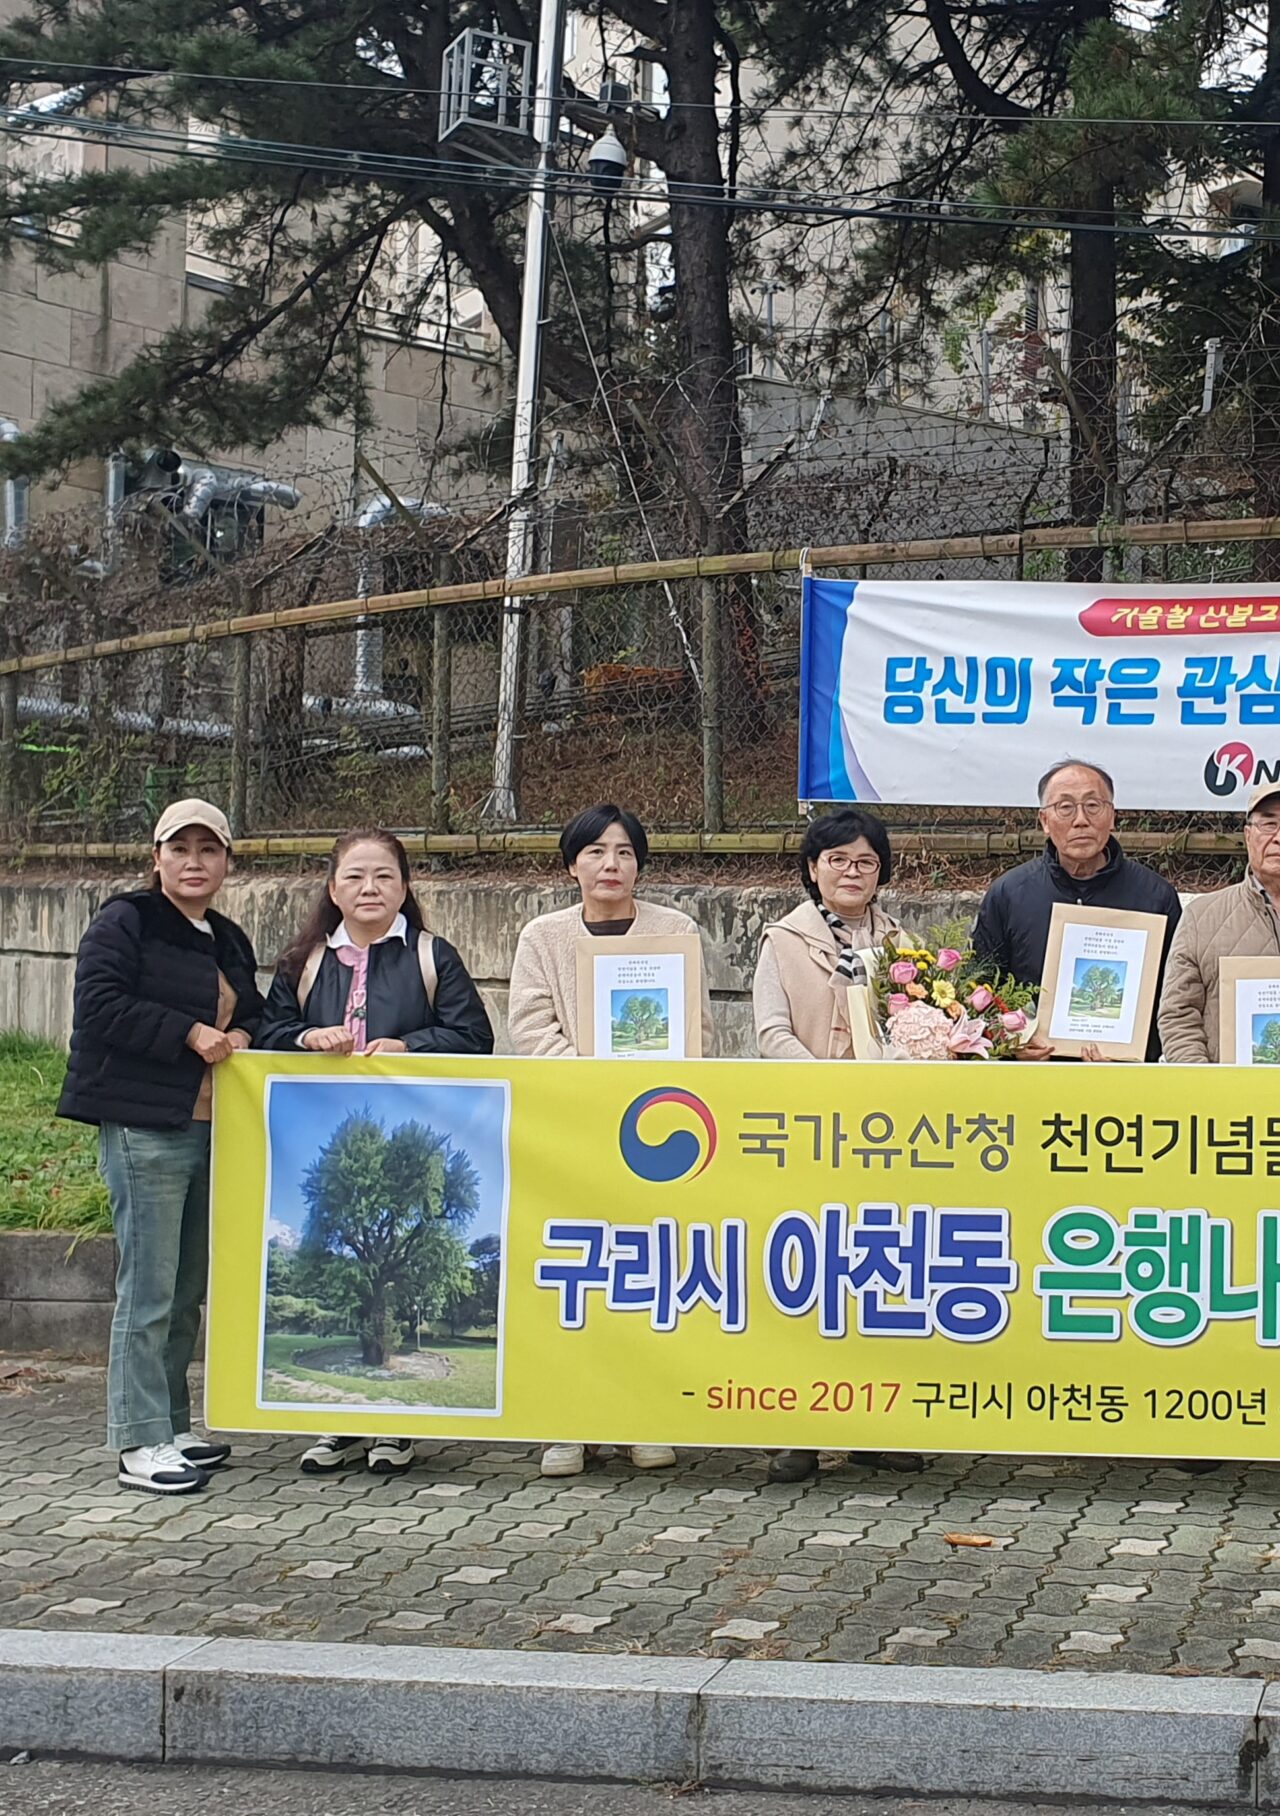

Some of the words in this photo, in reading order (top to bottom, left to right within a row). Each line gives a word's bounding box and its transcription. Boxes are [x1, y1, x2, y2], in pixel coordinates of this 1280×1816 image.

[1110, 605, 1193, 631] 가을철
[882, 655, 1034, 725] 당신의
[1049, 656, 1160, 726] 작은
[738, 1111, 1016, 1172] 국가유산청
[537, 1220, 743, 1329] 구리시
[766, 1205, 1016, 1340] 아천동
[706, 1379, 798, 1411] since
[809, 1381, 901, 1413] 2017
[912, 1381, 1014, 1420] 구리시
[1026, 1383, 1130, 1423] 아천동
[1142, 1388, 1268, 1427] 1200년
